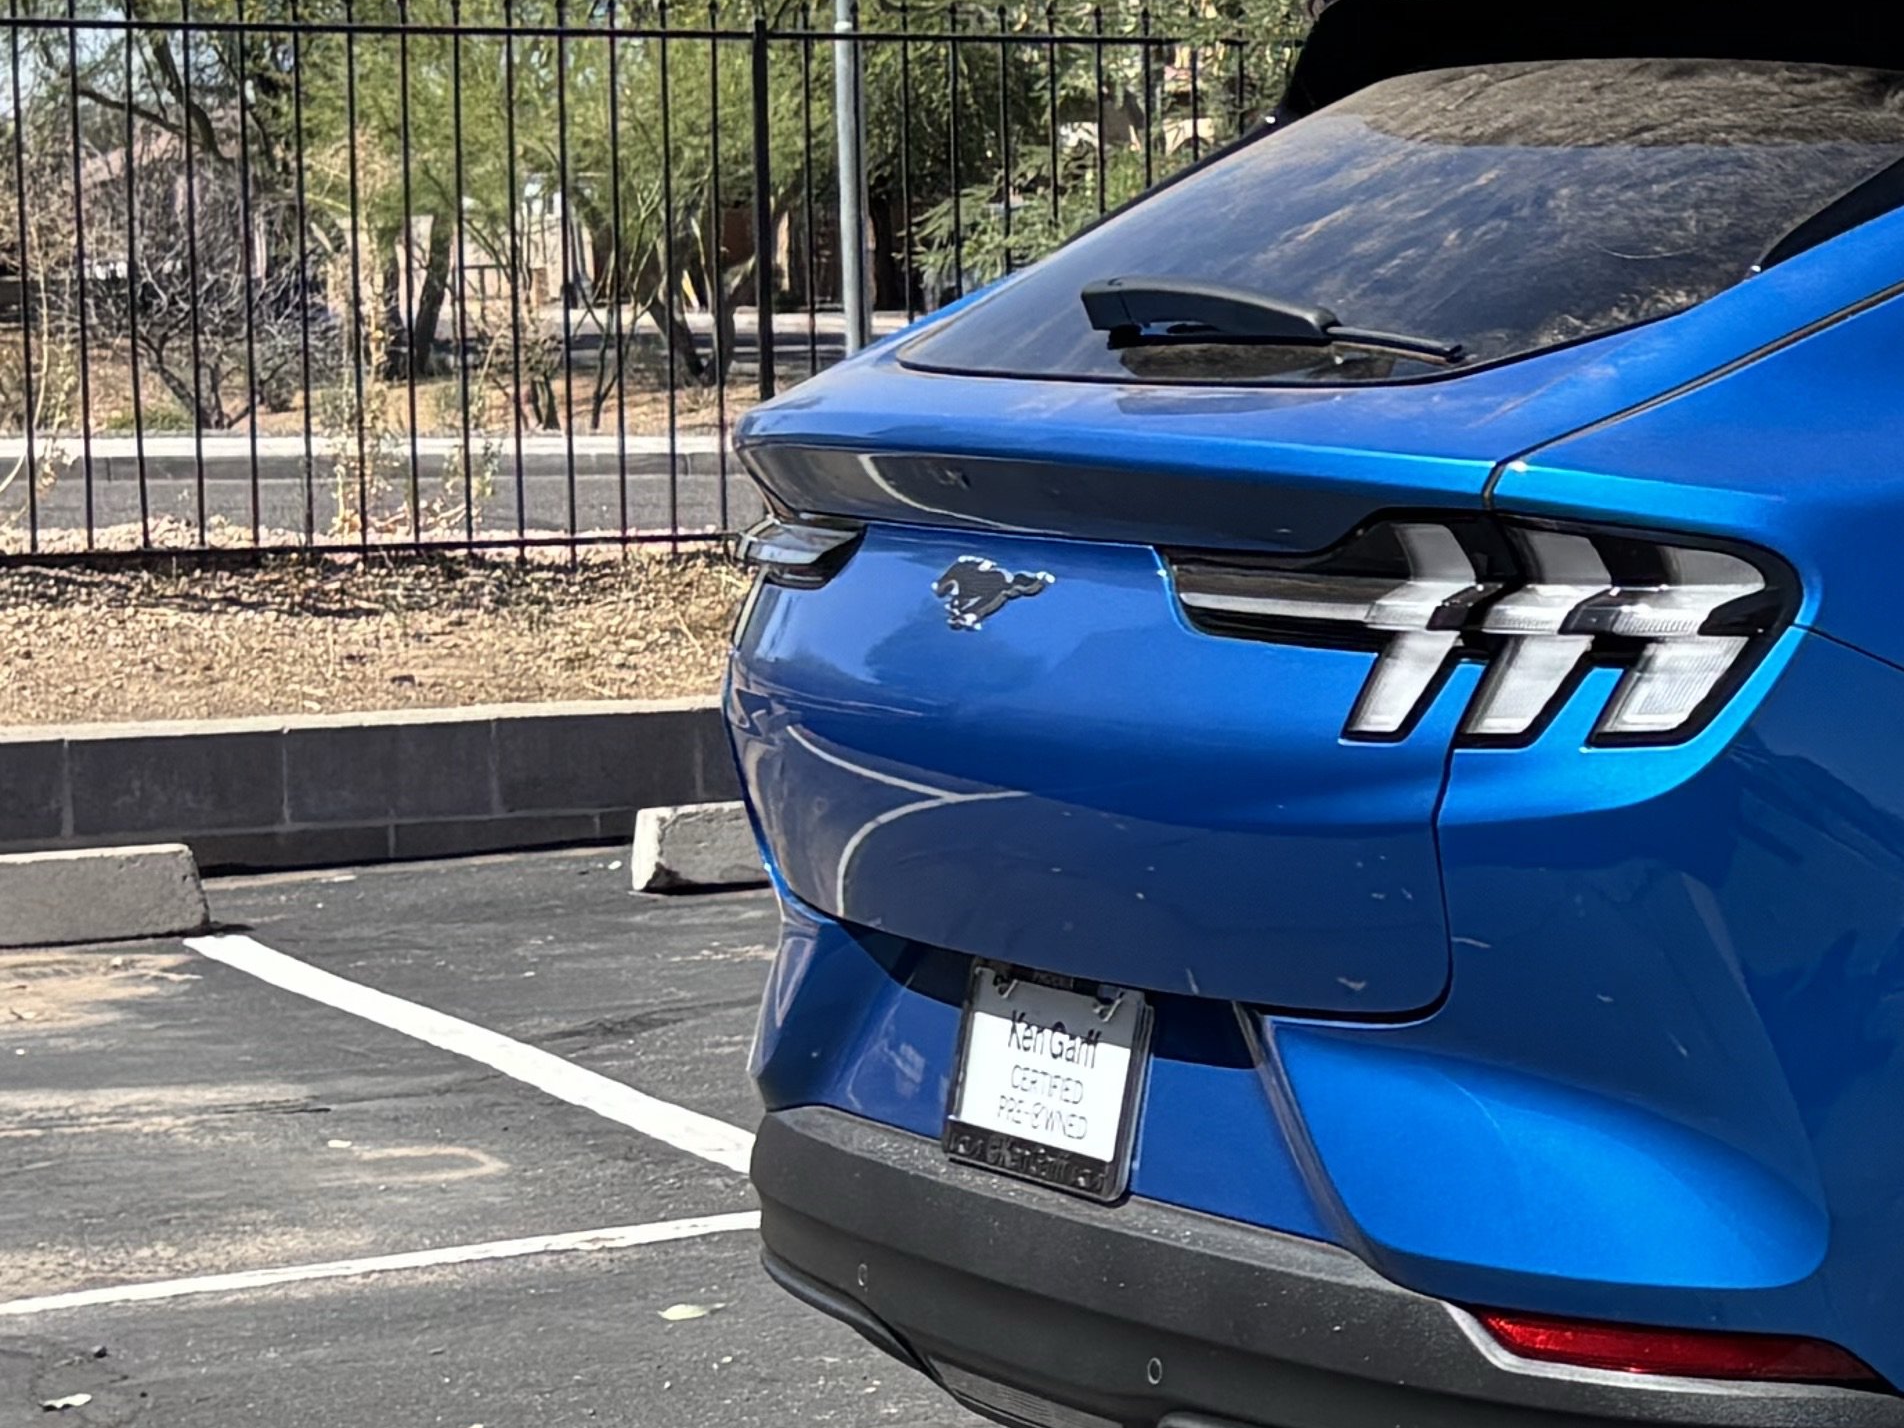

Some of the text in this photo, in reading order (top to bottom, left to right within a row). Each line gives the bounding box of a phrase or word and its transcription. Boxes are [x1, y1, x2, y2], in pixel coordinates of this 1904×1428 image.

[1008, 1009, 1103, 1069] Ken Garff
[1011, 1064, 1084, 1105] CERTIFIED
